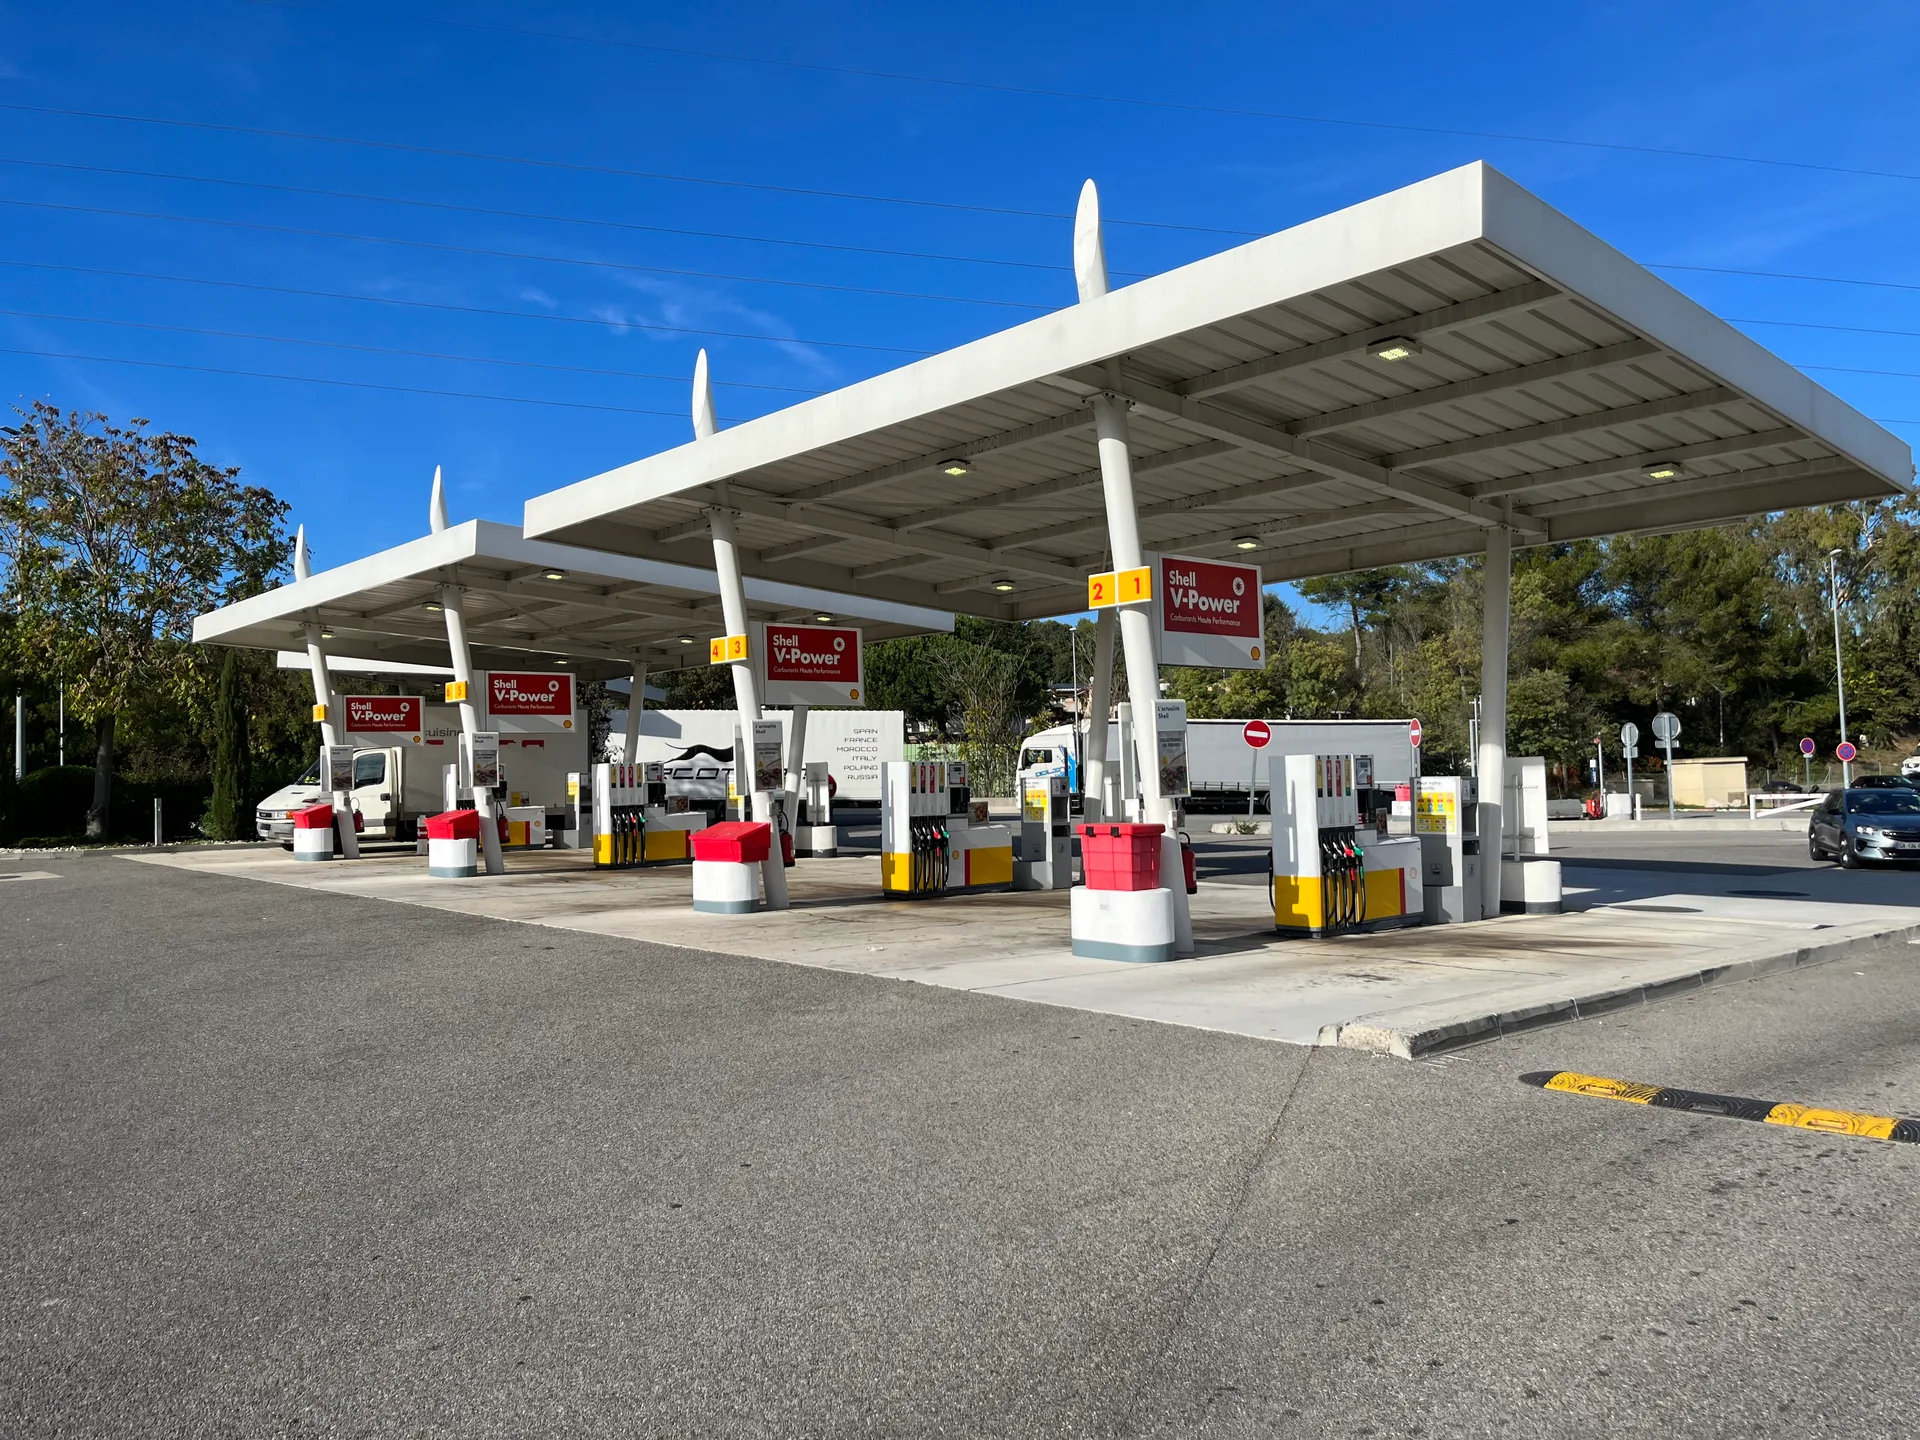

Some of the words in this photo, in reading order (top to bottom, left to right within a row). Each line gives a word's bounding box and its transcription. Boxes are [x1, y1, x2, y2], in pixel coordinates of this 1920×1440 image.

[1169, 569, 1196, 587] Shell
[1093, 583, 1103, 600] 2
[1134, 577, 1140, 594] 1
[1169, 587, 1240, 614] V-Power
[1170, 612, 1197, 623] Carburants
[1197, 615, 1212, 625] Haute
[1212, 616, 1241, 627] Performance
[773, 633, 799, 647] Shell
[713, 645, 719, 657] 4
[735, 641, 741, 653] 3
[773, 647, 841, 665] V-Power
[773, 665, 799, 674] Carburants
[813, 667, 841, 675] Performance
[494, 679, 517, 689] Shell
[494, 689, 555, 702] V-Power
[351, 702, 372, 710] Shell
[351, 710, 406, 721] V-Power
